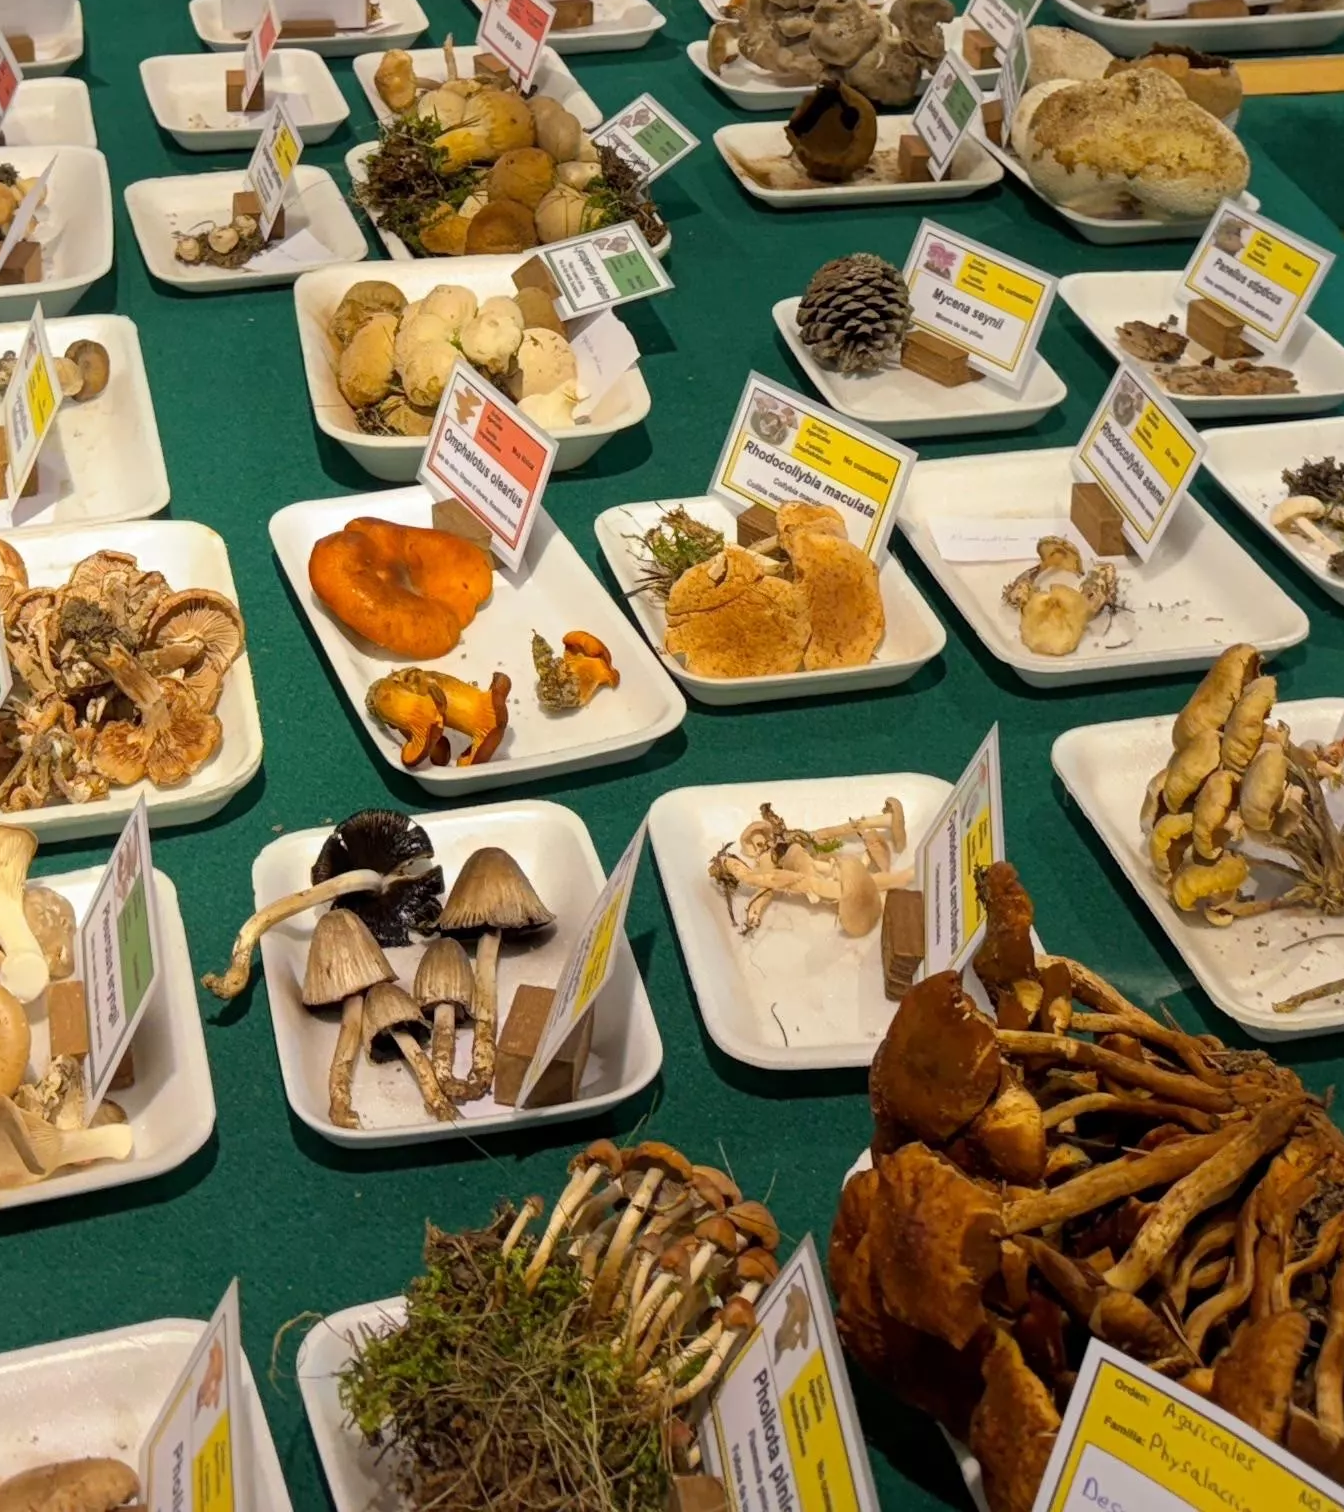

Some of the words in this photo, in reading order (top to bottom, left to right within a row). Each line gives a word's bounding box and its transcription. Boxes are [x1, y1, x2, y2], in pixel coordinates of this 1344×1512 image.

[931, 286, 971, 314] Mycena
[1212, 256, 1247, 284] Panellus
[443, 425, 490, 478] Omphalotus
[489, 472, 522, 510] olearius
[743, 439, 821, 489] Rhodocollybia
[822, 485, 875, 519] maculata
[1099, 418, 1144, 480] Rhodocollybia
[1142, 473, 1166, 507] asema
[102, 895, 112, 979] Pleurotus
[751, 1362, 781, 1465] Pholiota
[1103, 1415, 1147, 1447] Familia:
[1114, 1378, 1152, 1407] Orden:
[1162, 1403, 1258, 1473] Agaricales
